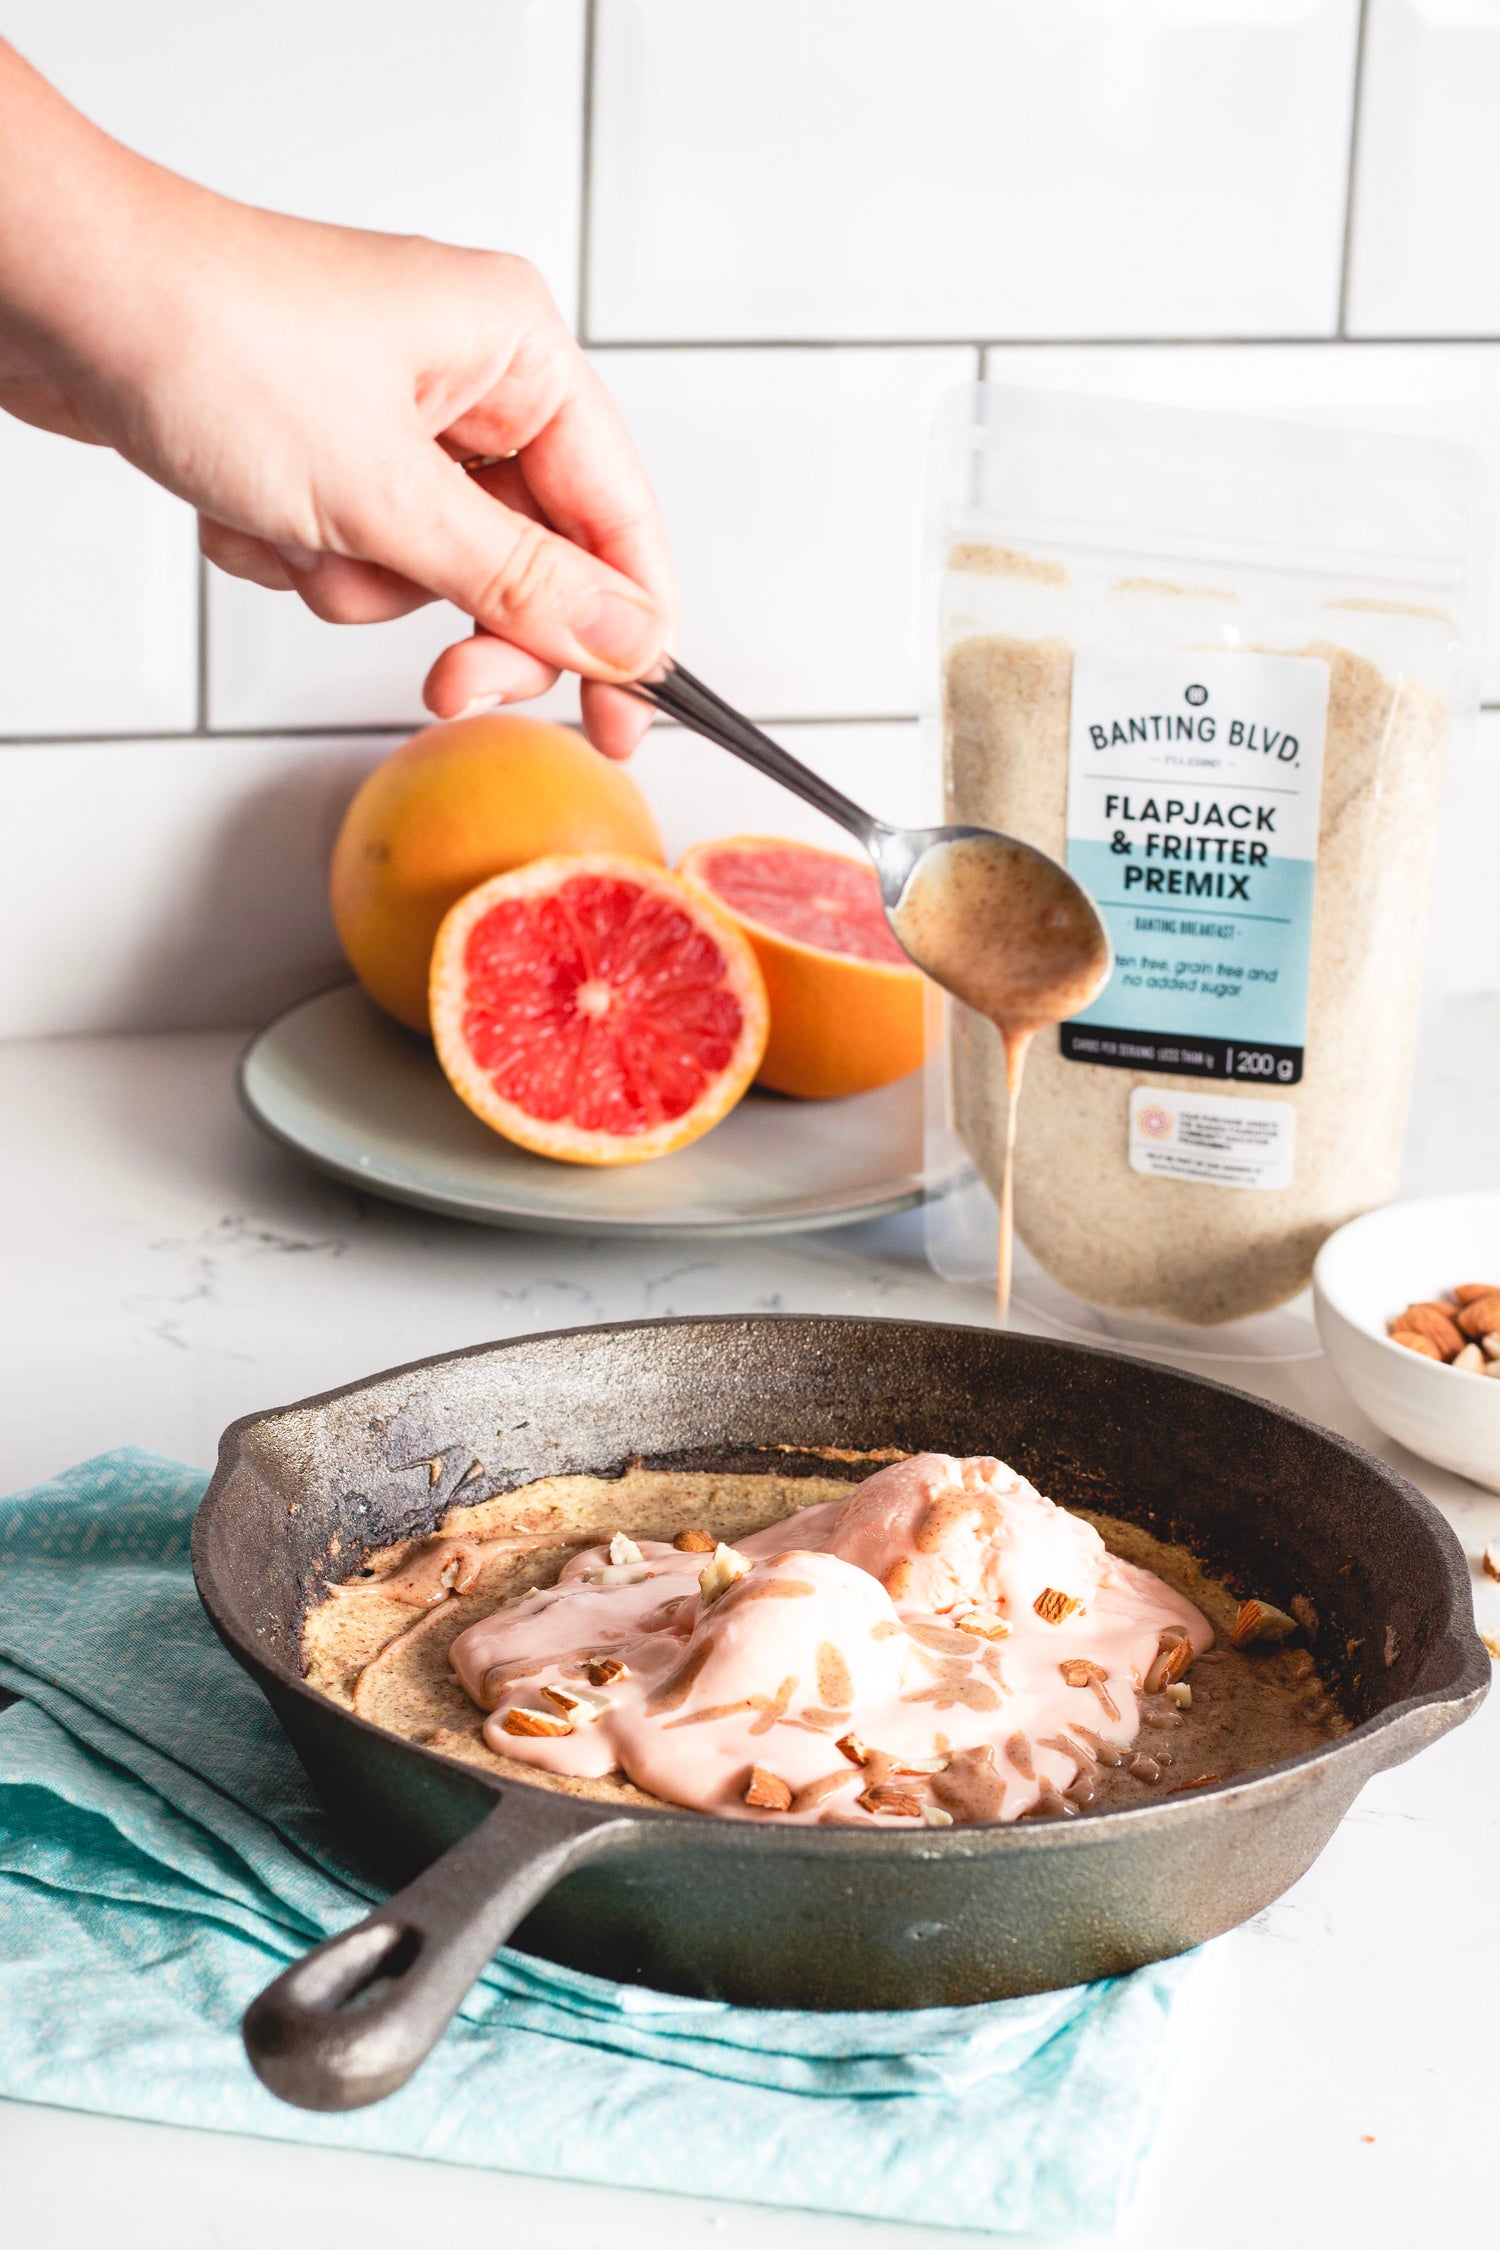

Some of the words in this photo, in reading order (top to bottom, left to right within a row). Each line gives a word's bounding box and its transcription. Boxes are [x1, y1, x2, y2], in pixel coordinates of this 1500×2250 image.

[1089, 714, 1217, 750] BANTING
[1228, 719, 1300, 768] BLVD.
[1105, 794, 1276, 832] FLAPJACK
[1109, 829, 1132, 855] &
[1145, 832, 1268, 867] FRITTER
[1123, 864, 1251, 901] PREMIX
[1134, 916, 1177, 935] BANTING
[1180, 919, 1235, 940] BREAKFAST
[1121, 974, 1142, 987] no
[1146, 975, 1197, 993] added
[1200, 981, 1242, 999] sugar
[1174, 960, 1214, 977] grain
[1216, 962, 1244, 978] free
[1247, 967, 1279, 983] and
[1237, 1050, 1275, 1075] 200
[1277, 1059, 1295, 1082] g
